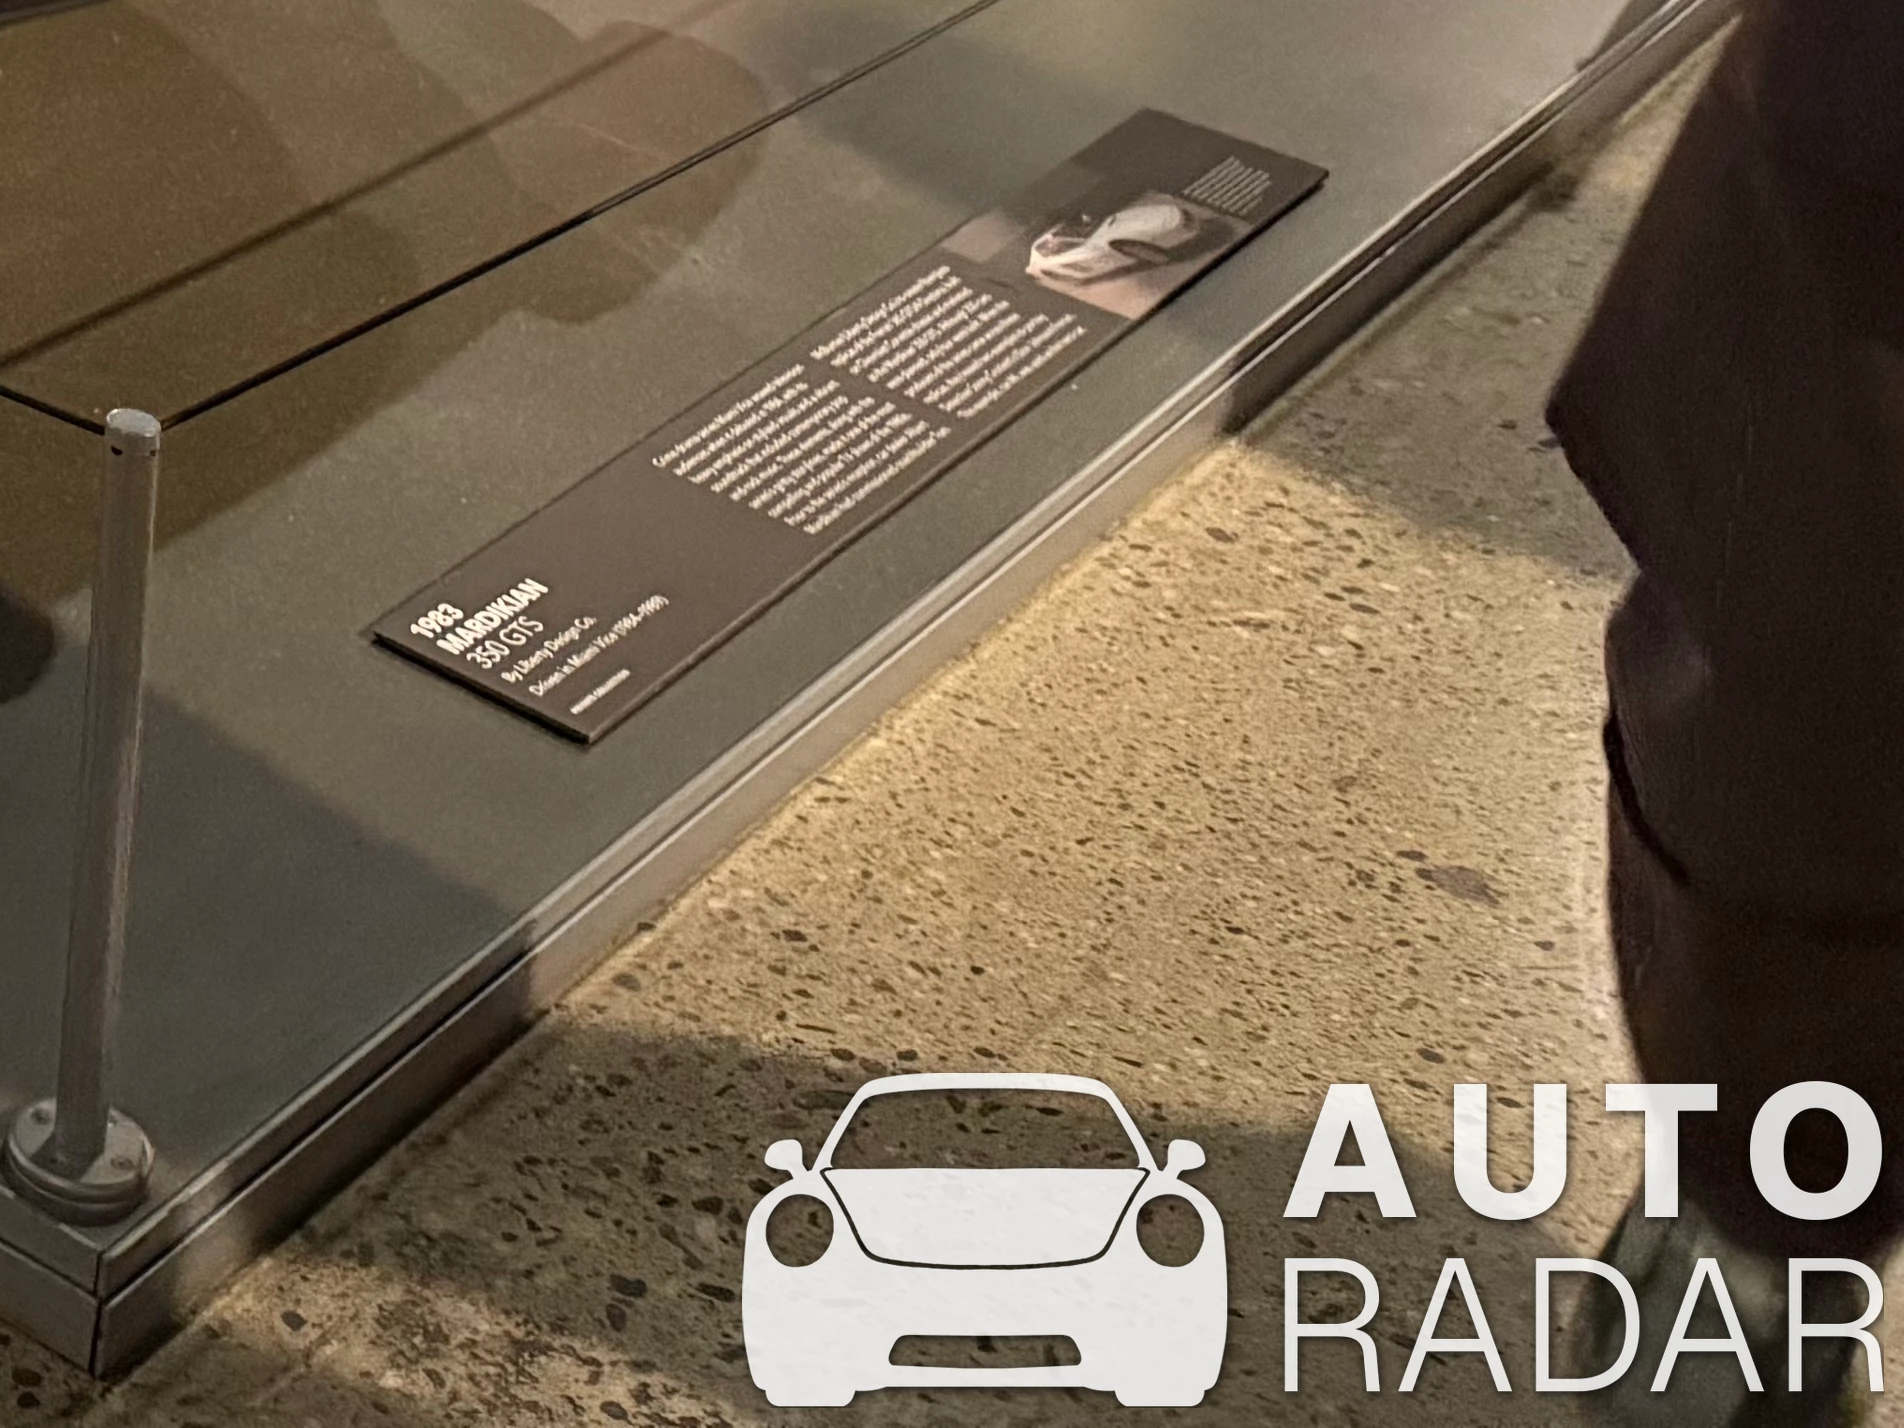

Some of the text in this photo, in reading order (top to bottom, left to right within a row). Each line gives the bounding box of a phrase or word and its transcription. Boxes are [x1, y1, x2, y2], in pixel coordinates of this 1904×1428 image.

[408, 602, 464, 640] 1983
[435, 577, 550, 656] MARDIKIAN
[465, 615, 545, 669] 350 GTS
